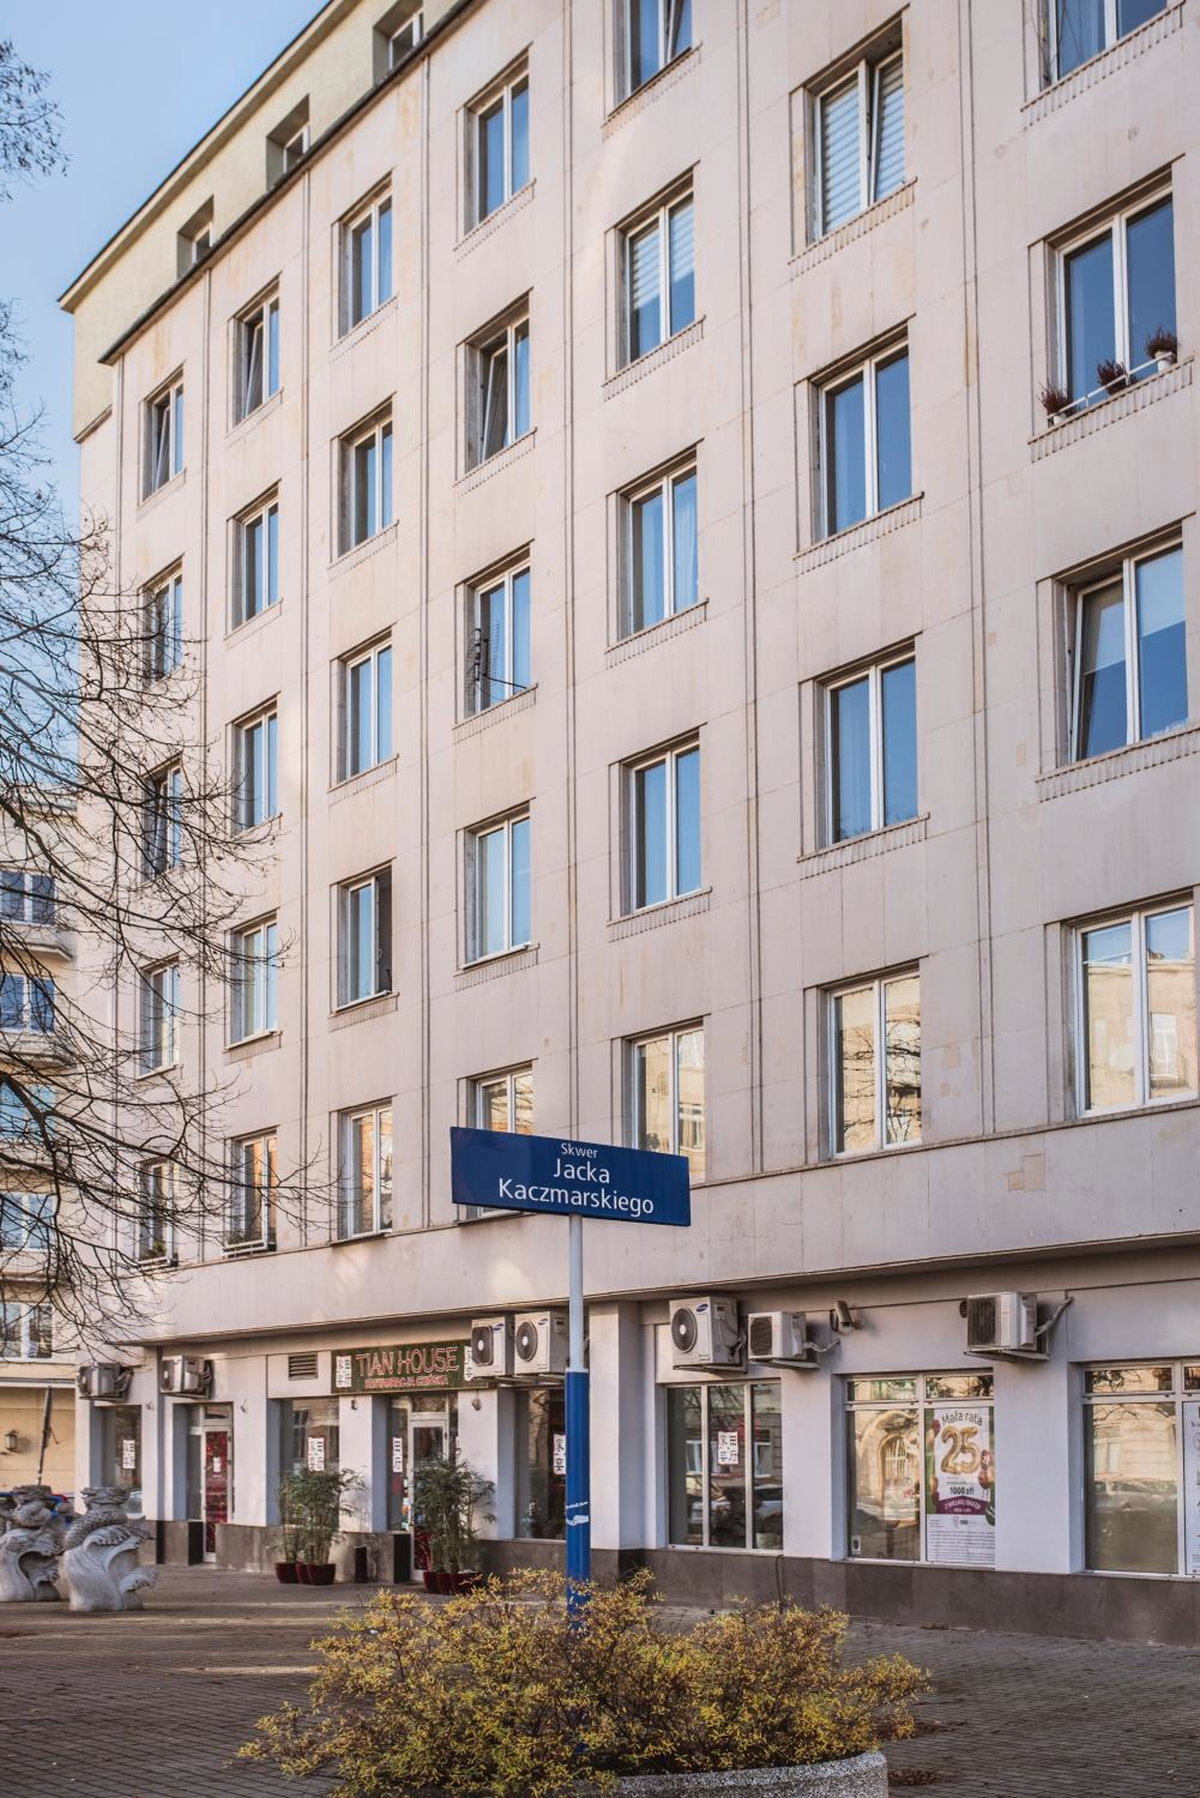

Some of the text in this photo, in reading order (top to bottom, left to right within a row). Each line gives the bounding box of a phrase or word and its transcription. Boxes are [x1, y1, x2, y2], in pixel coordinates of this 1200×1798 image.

[560, 1143, 598, 1159] Skwer
[553, 1158, 610, 1184] Jacka
[498, 1178, 654, 1217] Kaczmarskiego
[355, 1351, 394, 1377] TIAN
[397, 1346, 460, 1374] HOUSE
[965, 1412, 983, 1426] rata
[941, 1426, 981, 1475] 25
